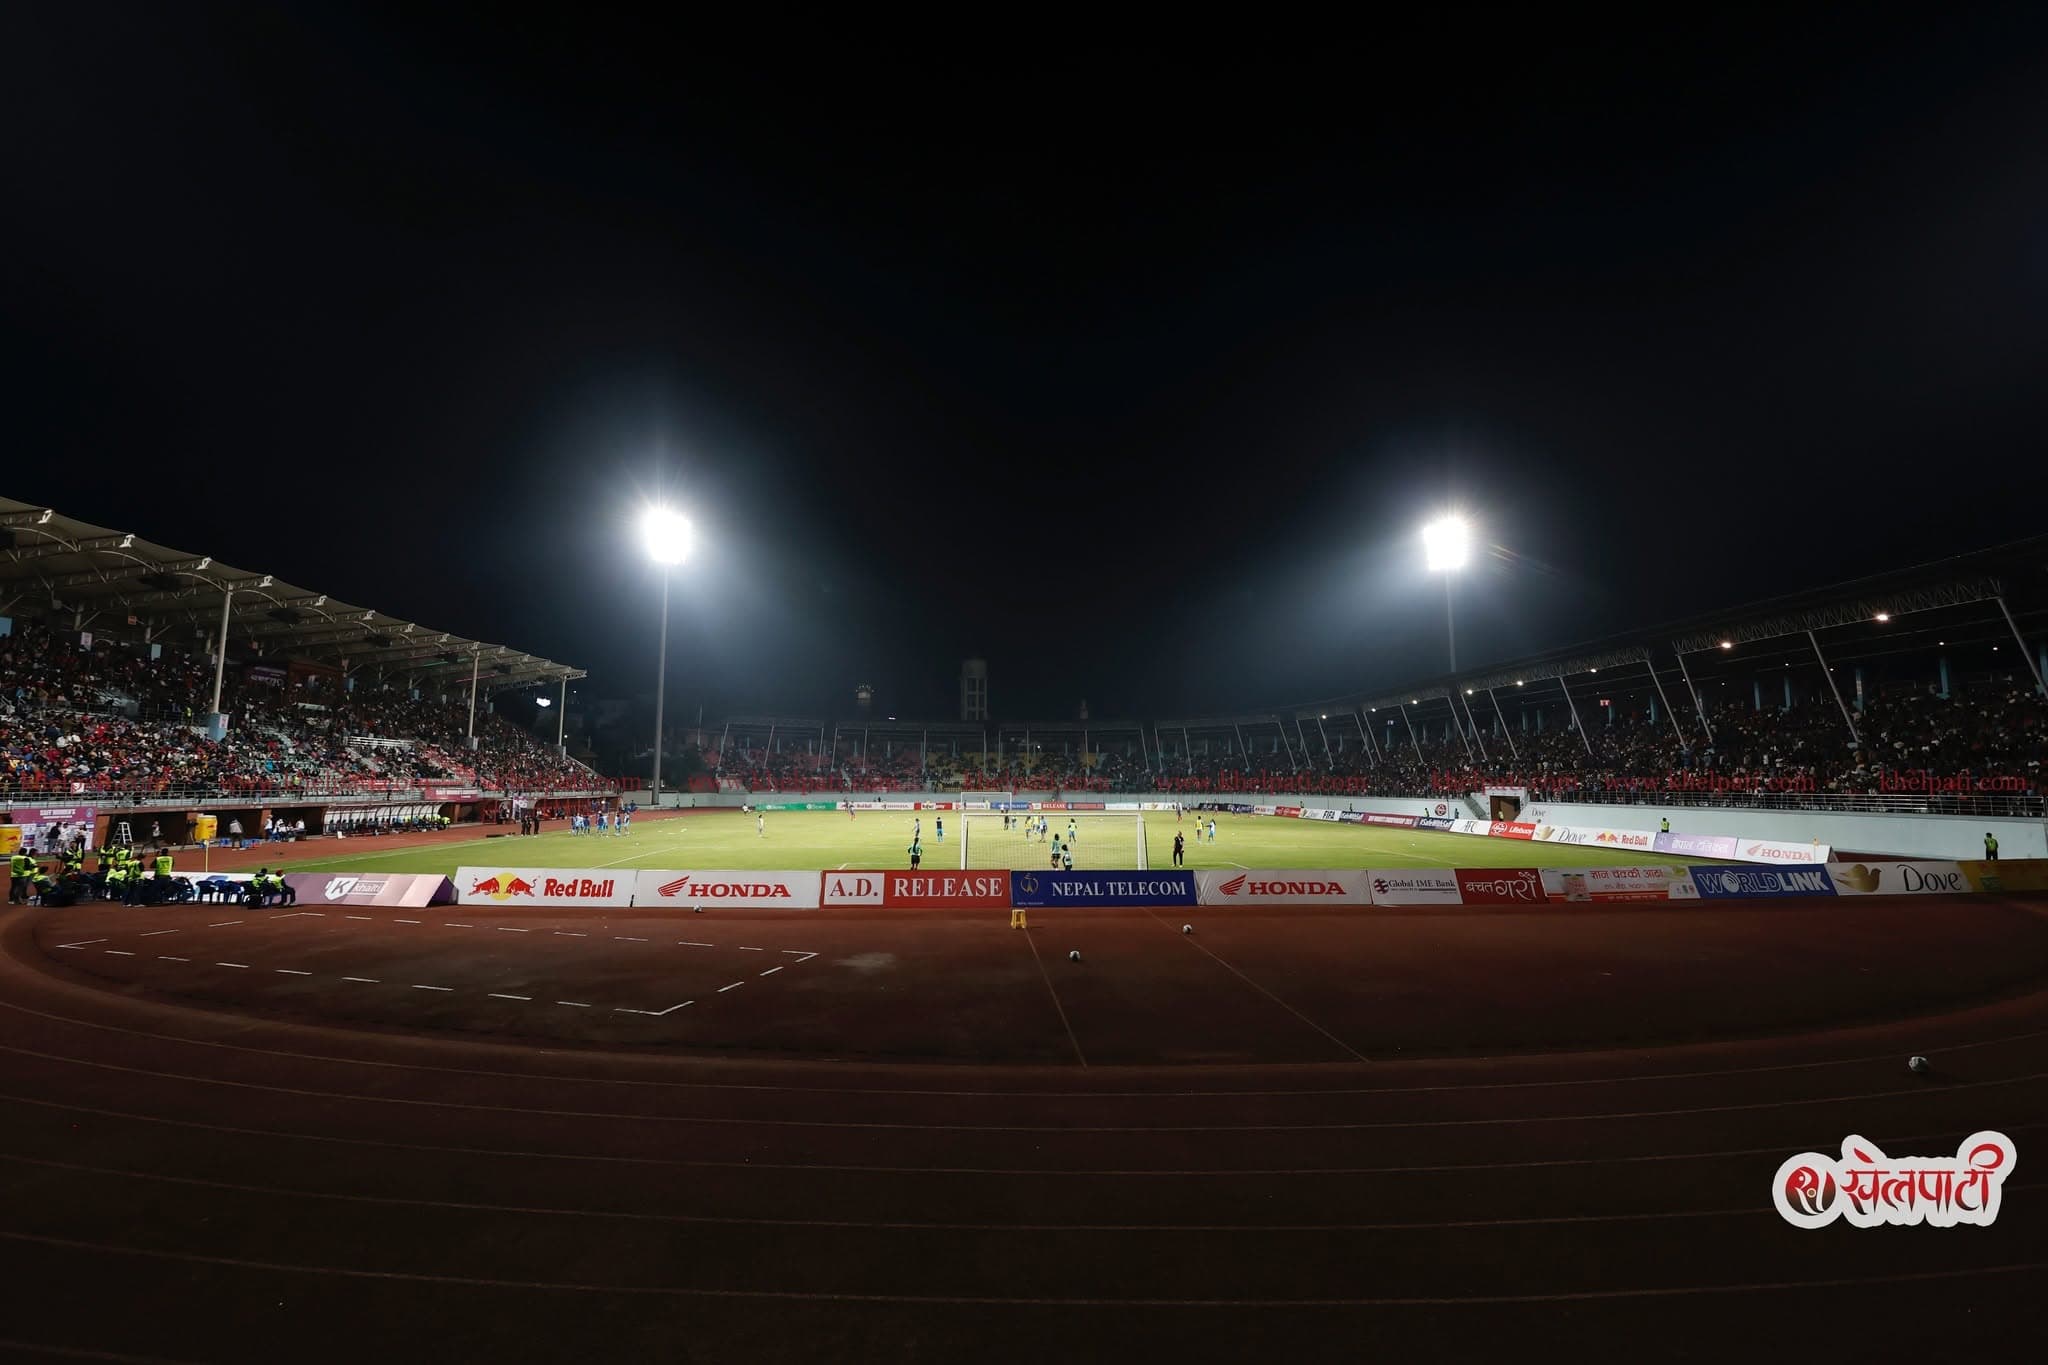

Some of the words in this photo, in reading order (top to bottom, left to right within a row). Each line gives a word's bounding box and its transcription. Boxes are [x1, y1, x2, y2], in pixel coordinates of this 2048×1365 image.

[1322, 810, 1336, 819] FIFA
[1464, 820, 1478, 832] AFC
[1509, 825, 1533, 835] Lifebuoy
[1559, 827, 1586, 842] Dove
[1621, 834, 1635, 845] Red
[1635, 835, 1648, 846] Bull
[1761, 849, 1813, 861] HONDA
[1389, 879, 1414, 889] Global
[1416, 880, 1433, 888] IME
[1436, 880, 1456, 888] Bank
[1698, 870, 1830, 894] WORLDLINK
[1897, 863, 1961, 891] Dove
[543, 877, 577, 898] Red
[579, 878, 614, 898] Bull
[687, 883, 791, 898] HONDA
[829, 877, 878, 897] A.D.
[893, 877, 1003, 897] RELEASE
[1052, 881, 1101, 897] NEPAL
[1103, 880, 1186, 897] TELECOM
[1247, 881, 1347, 896] HONDA
[1464, 881, 1494, 893] बचत
